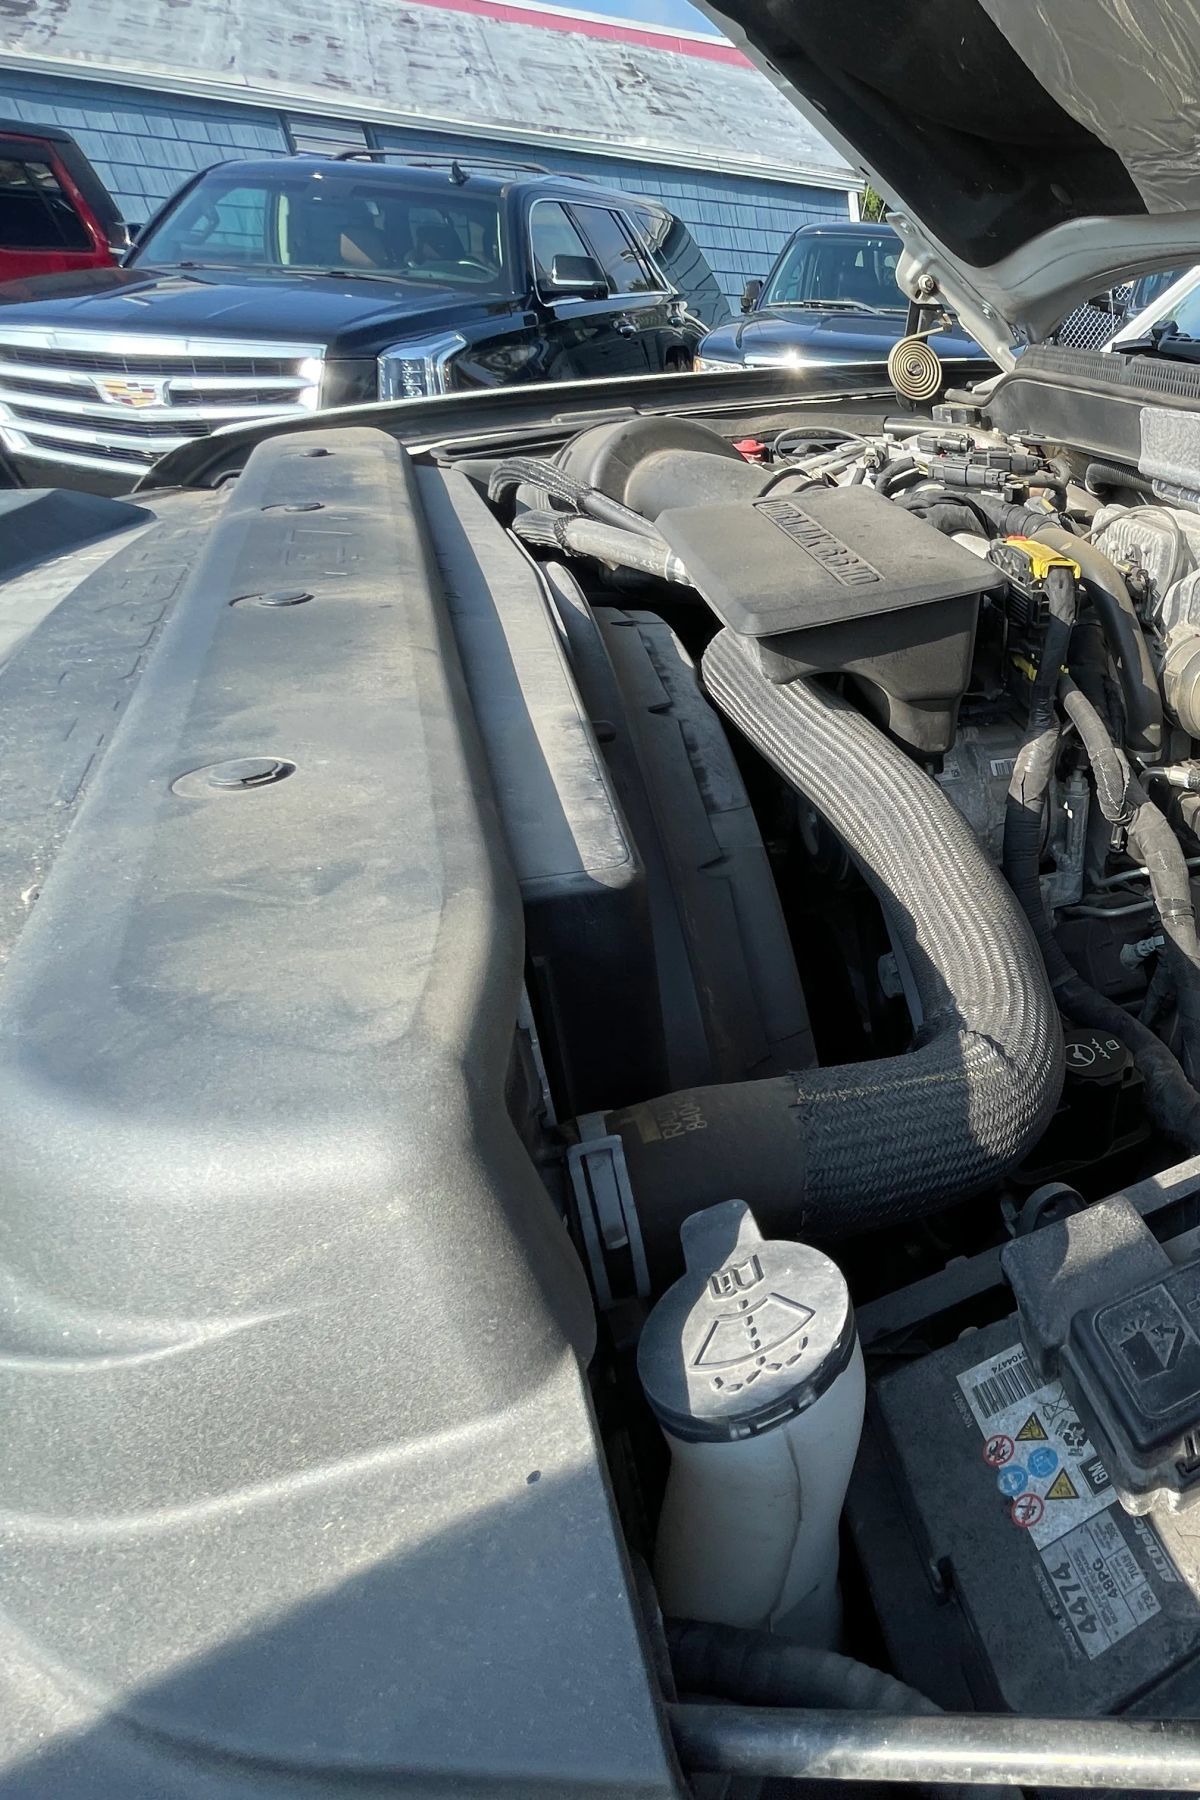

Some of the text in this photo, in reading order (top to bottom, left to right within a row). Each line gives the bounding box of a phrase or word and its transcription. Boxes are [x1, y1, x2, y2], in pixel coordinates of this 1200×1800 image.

[1088, 1461, 1109, 1485] GM
[1133, 1516, 1177, 1583] ACDelc
[1051, 1562, 1097, 1633] 4474
[1092, 1558, 1118, 1599] 48PG
